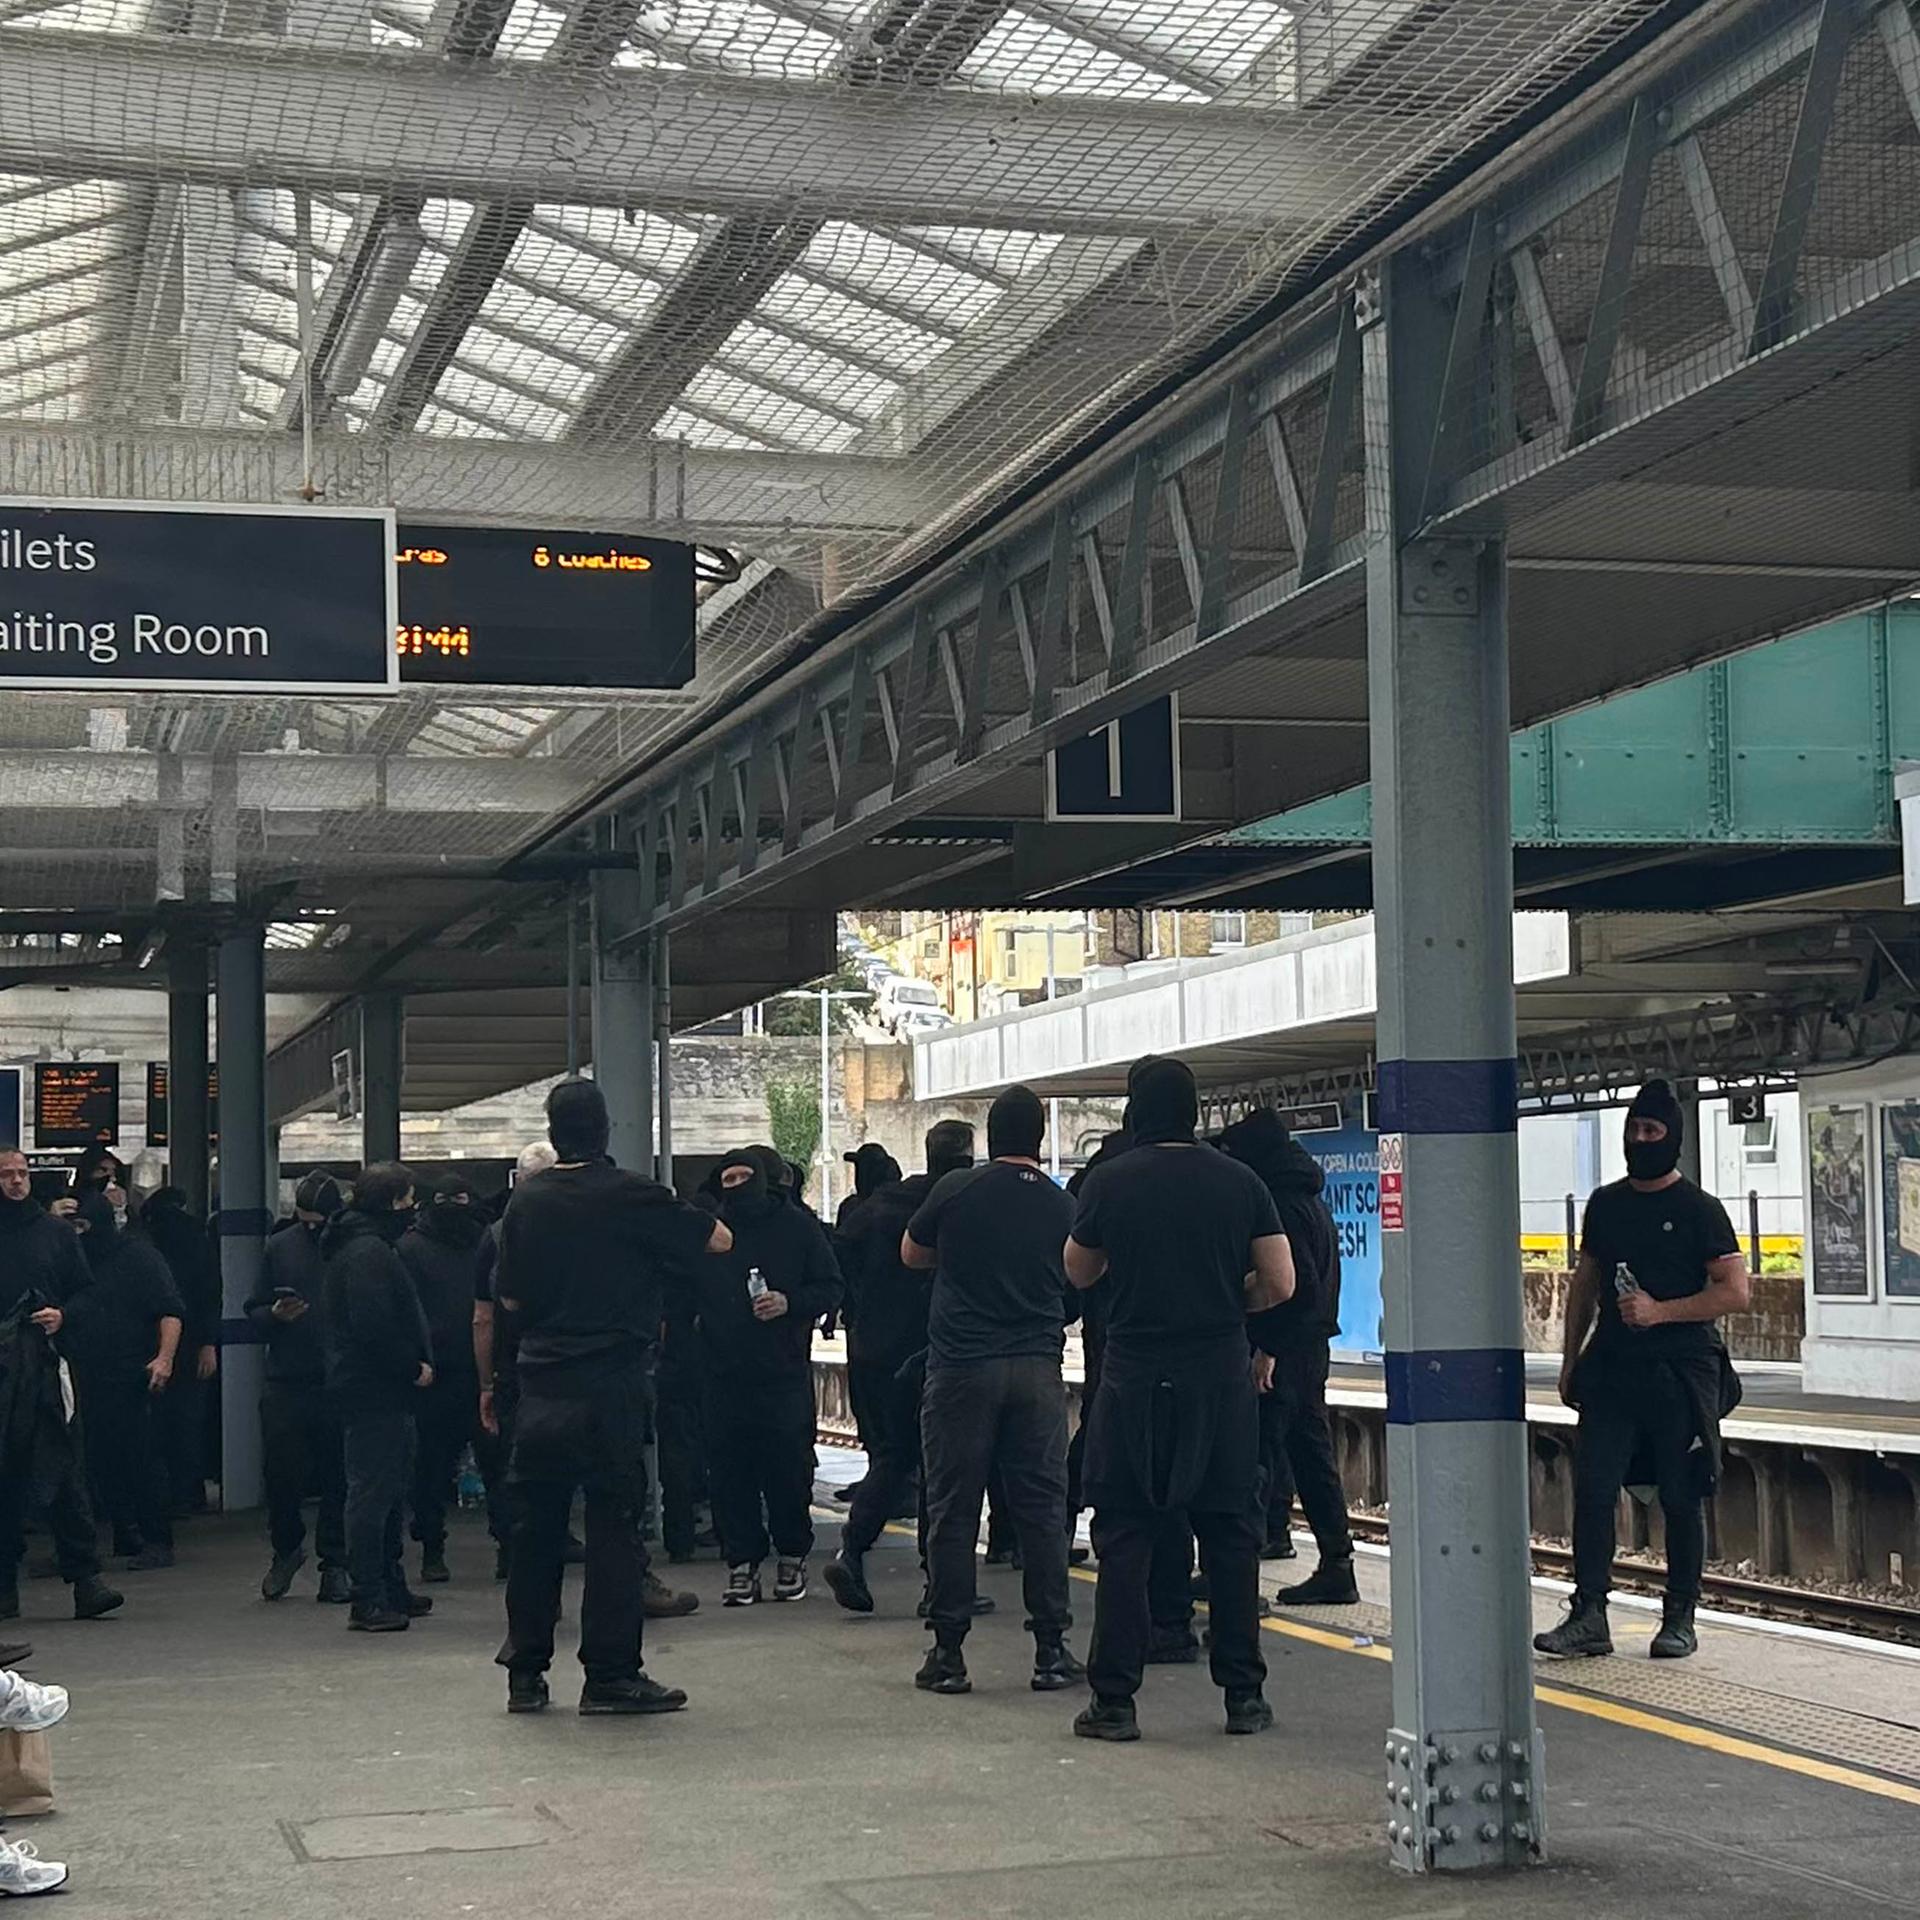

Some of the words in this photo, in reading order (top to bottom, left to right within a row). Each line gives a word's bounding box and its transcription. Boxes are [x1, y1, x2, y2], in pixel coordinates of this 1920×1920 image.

[1, 529, 97, 571] ilets
[133, 614, 269, 656] Room
[1088, 718, 1122, 798] 1
[1741, 1095, 1758, 1119] 3
